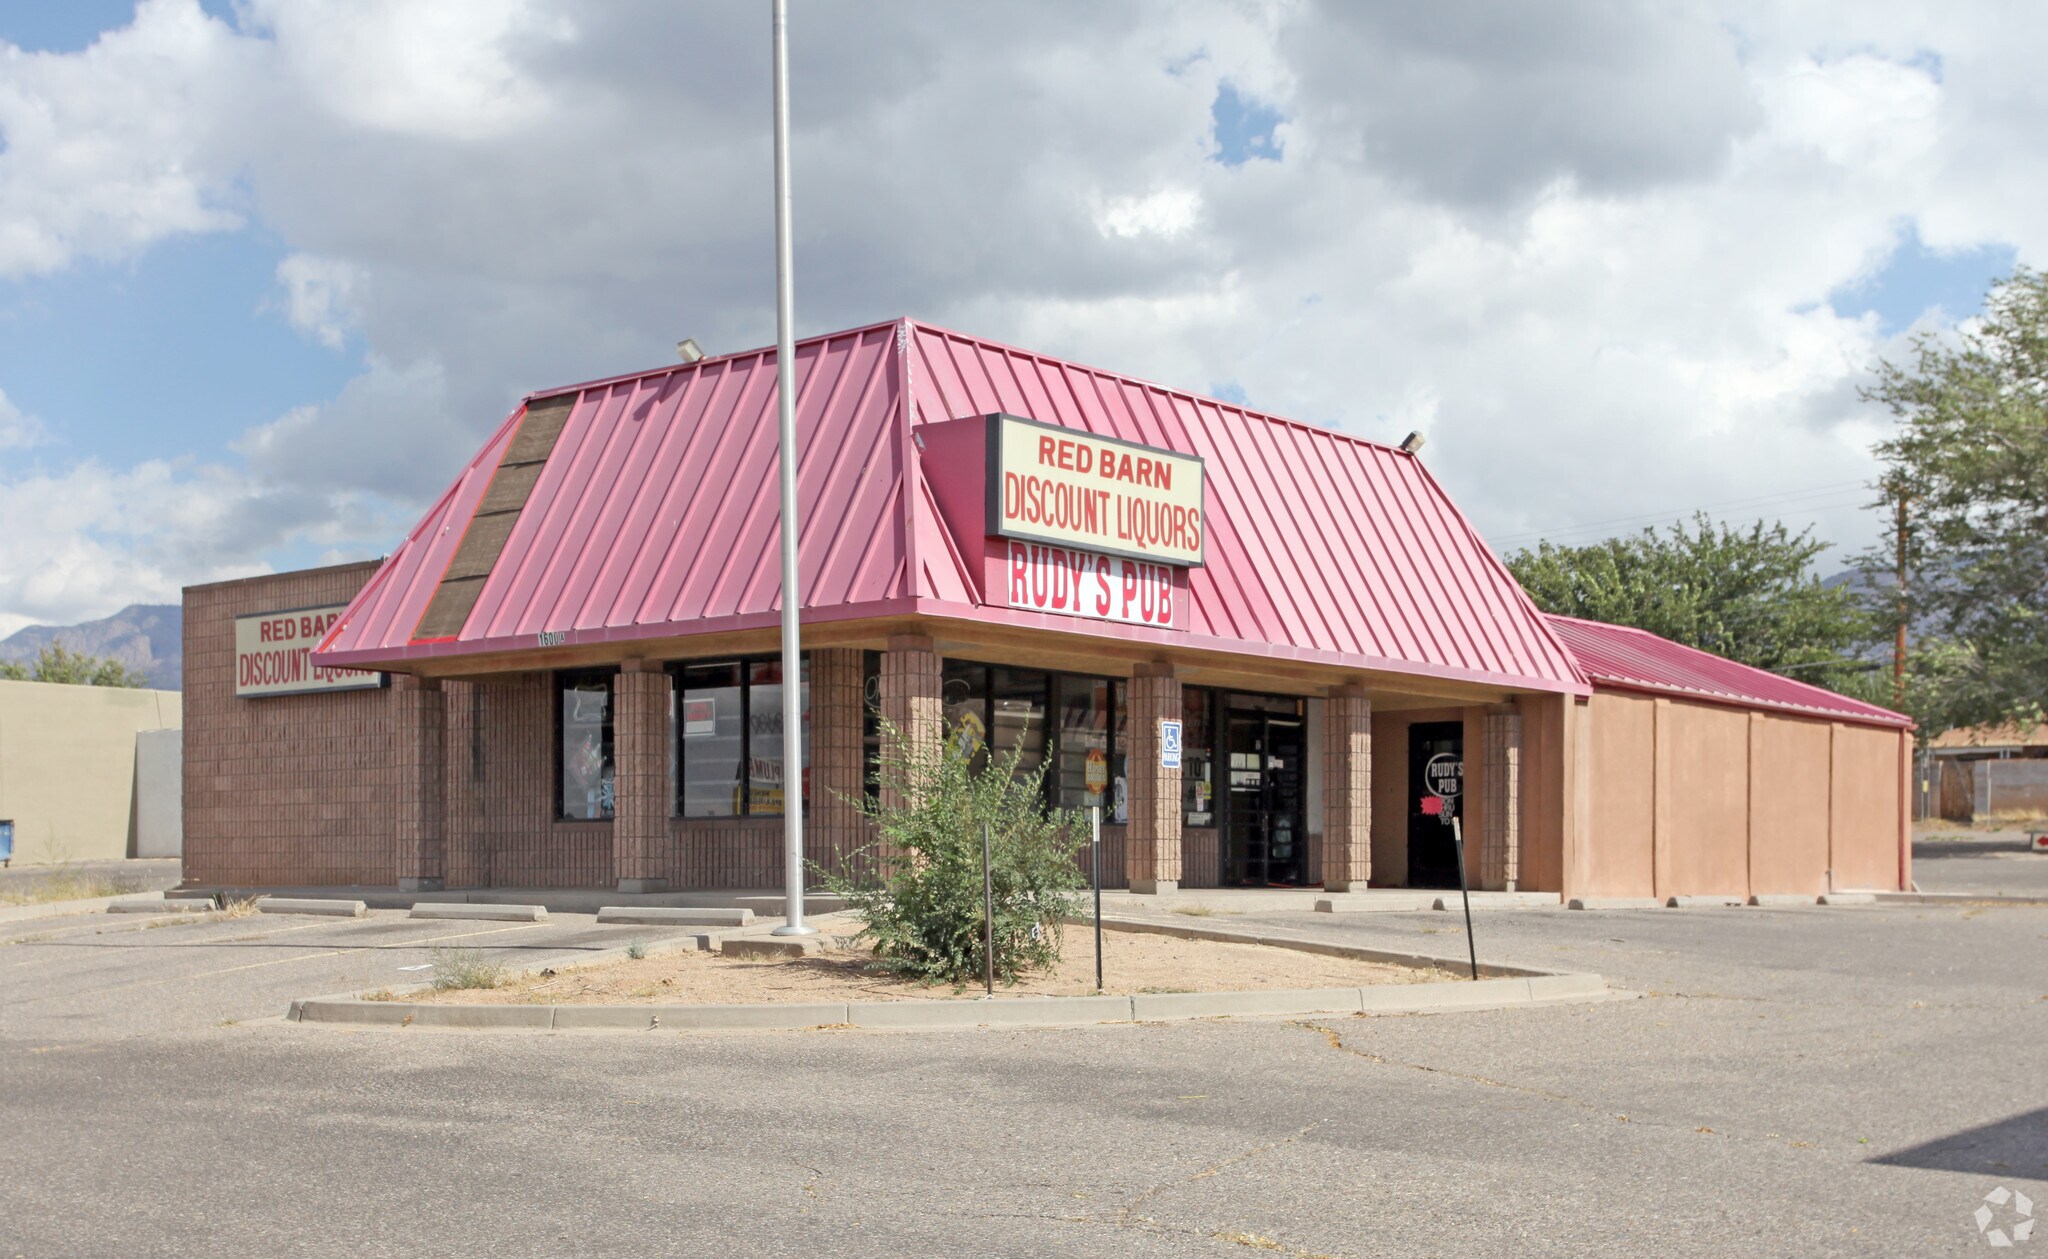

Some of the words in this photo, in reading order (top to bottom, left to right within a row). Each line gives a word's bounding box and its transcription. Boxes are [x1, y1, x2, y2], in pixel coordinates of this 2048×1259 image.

[1038, 435, 1093, 474] RED
[1099, 448, 1172, 491] BARN
[1005, 471, 1110, 536] DISCOUNT
[1117, 494, 1200, 552] LIQUORS
[1010, 541, 1112, 617] RUDY'S
[1121, 560, 1172, 624] PUB
[260, 618, 296, 642] RED
[301, 612, 342, 639] BAR
[240, 648, 310, 686] DISCOUNT
[1431, 761, 1463, 777] RUDY'S
[1438, 778, 1457, 793] PUB
